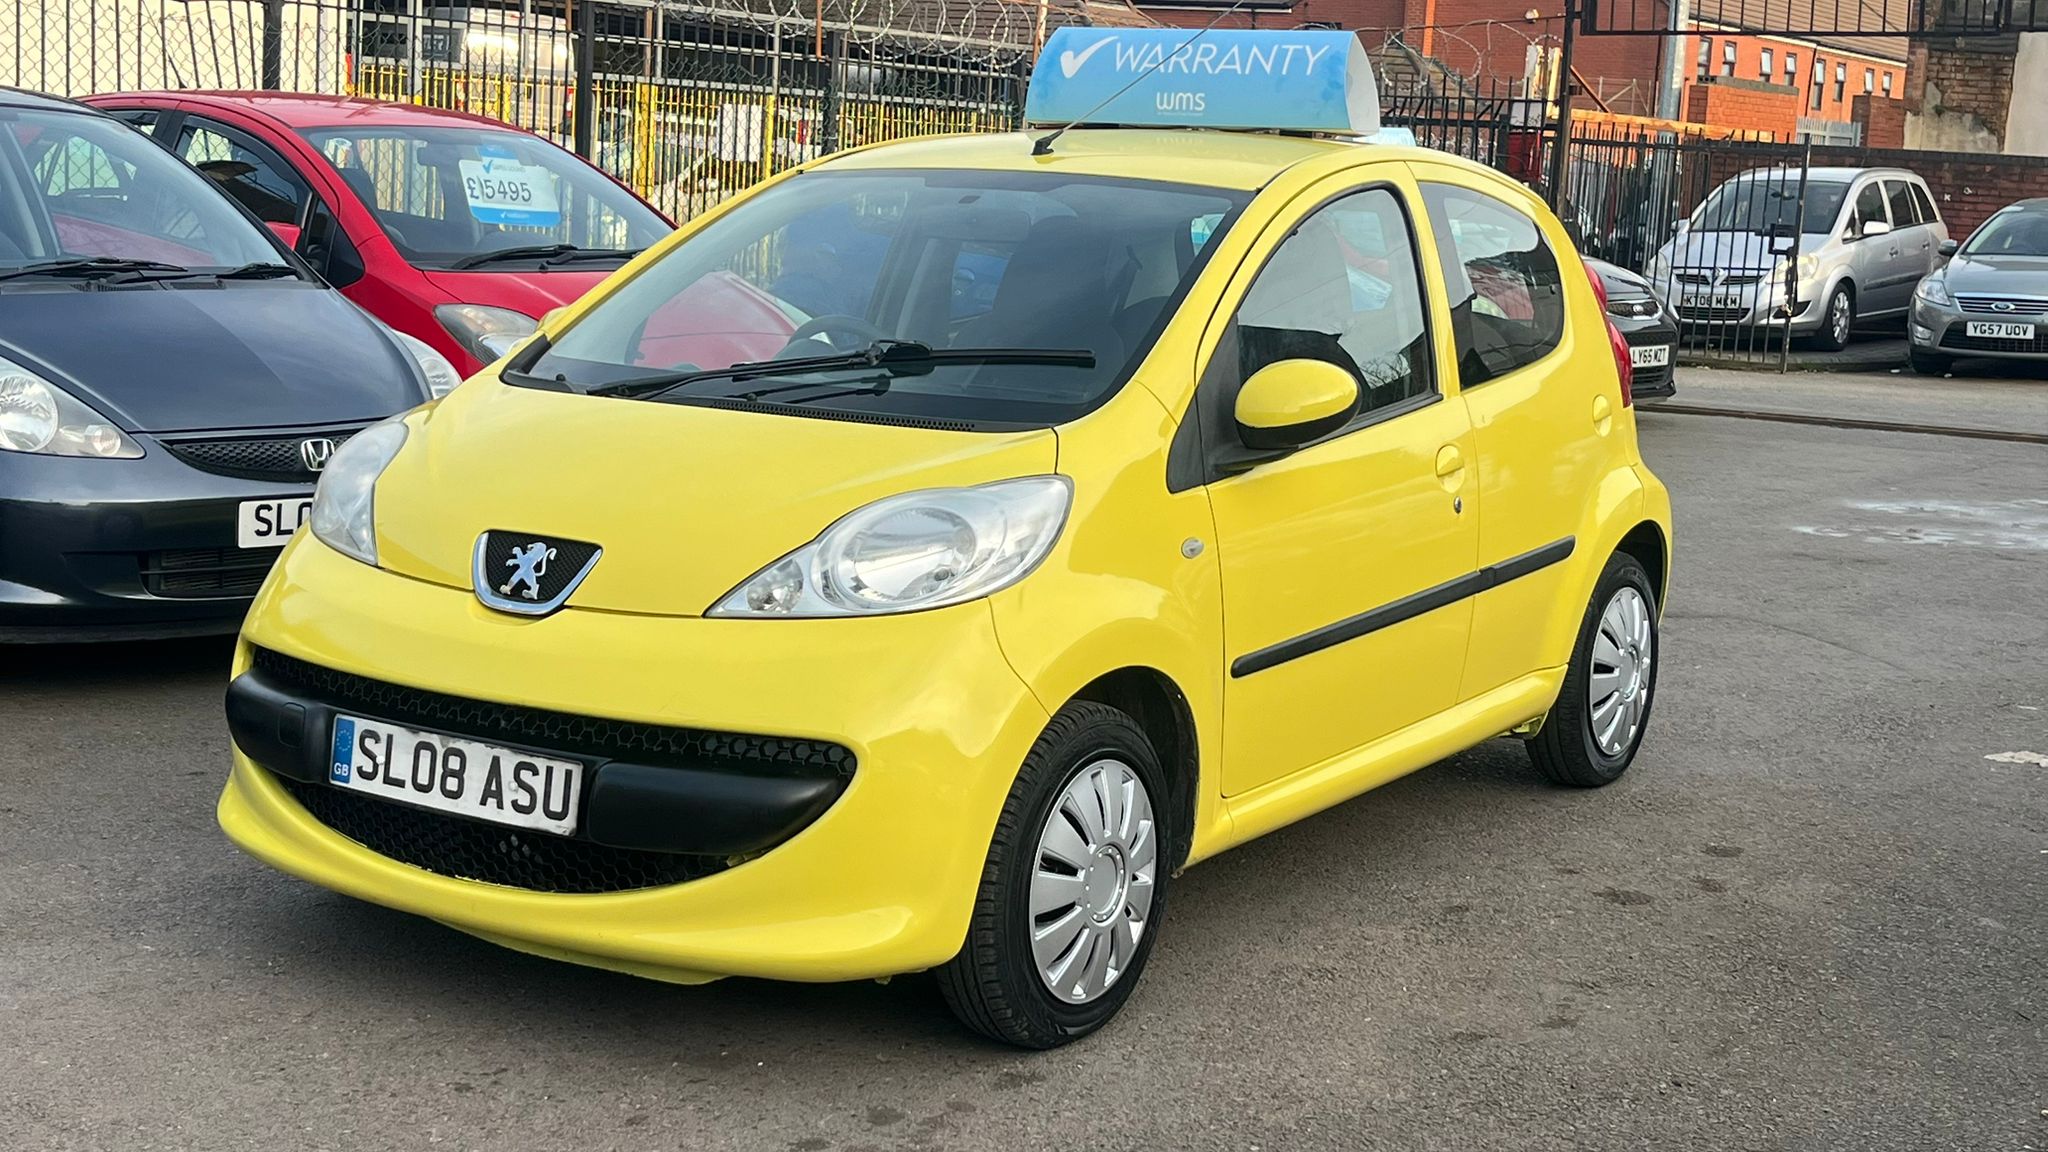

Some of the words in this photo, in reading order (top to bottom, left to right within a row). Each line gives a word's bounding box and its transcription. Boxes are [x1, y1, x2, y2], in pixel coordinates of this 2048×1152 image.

[1114, 42, 1330, 76] WARRANTY
[1156, 92, 1205, 111] wms
[1972, 323, 2002, 336] YG57
[2005, 325, 2029, 337] UOV
[333, 762, 350, 777] GB
[356, 728, 467, 800] SL08
[479, 755, 574, 821] ASU
